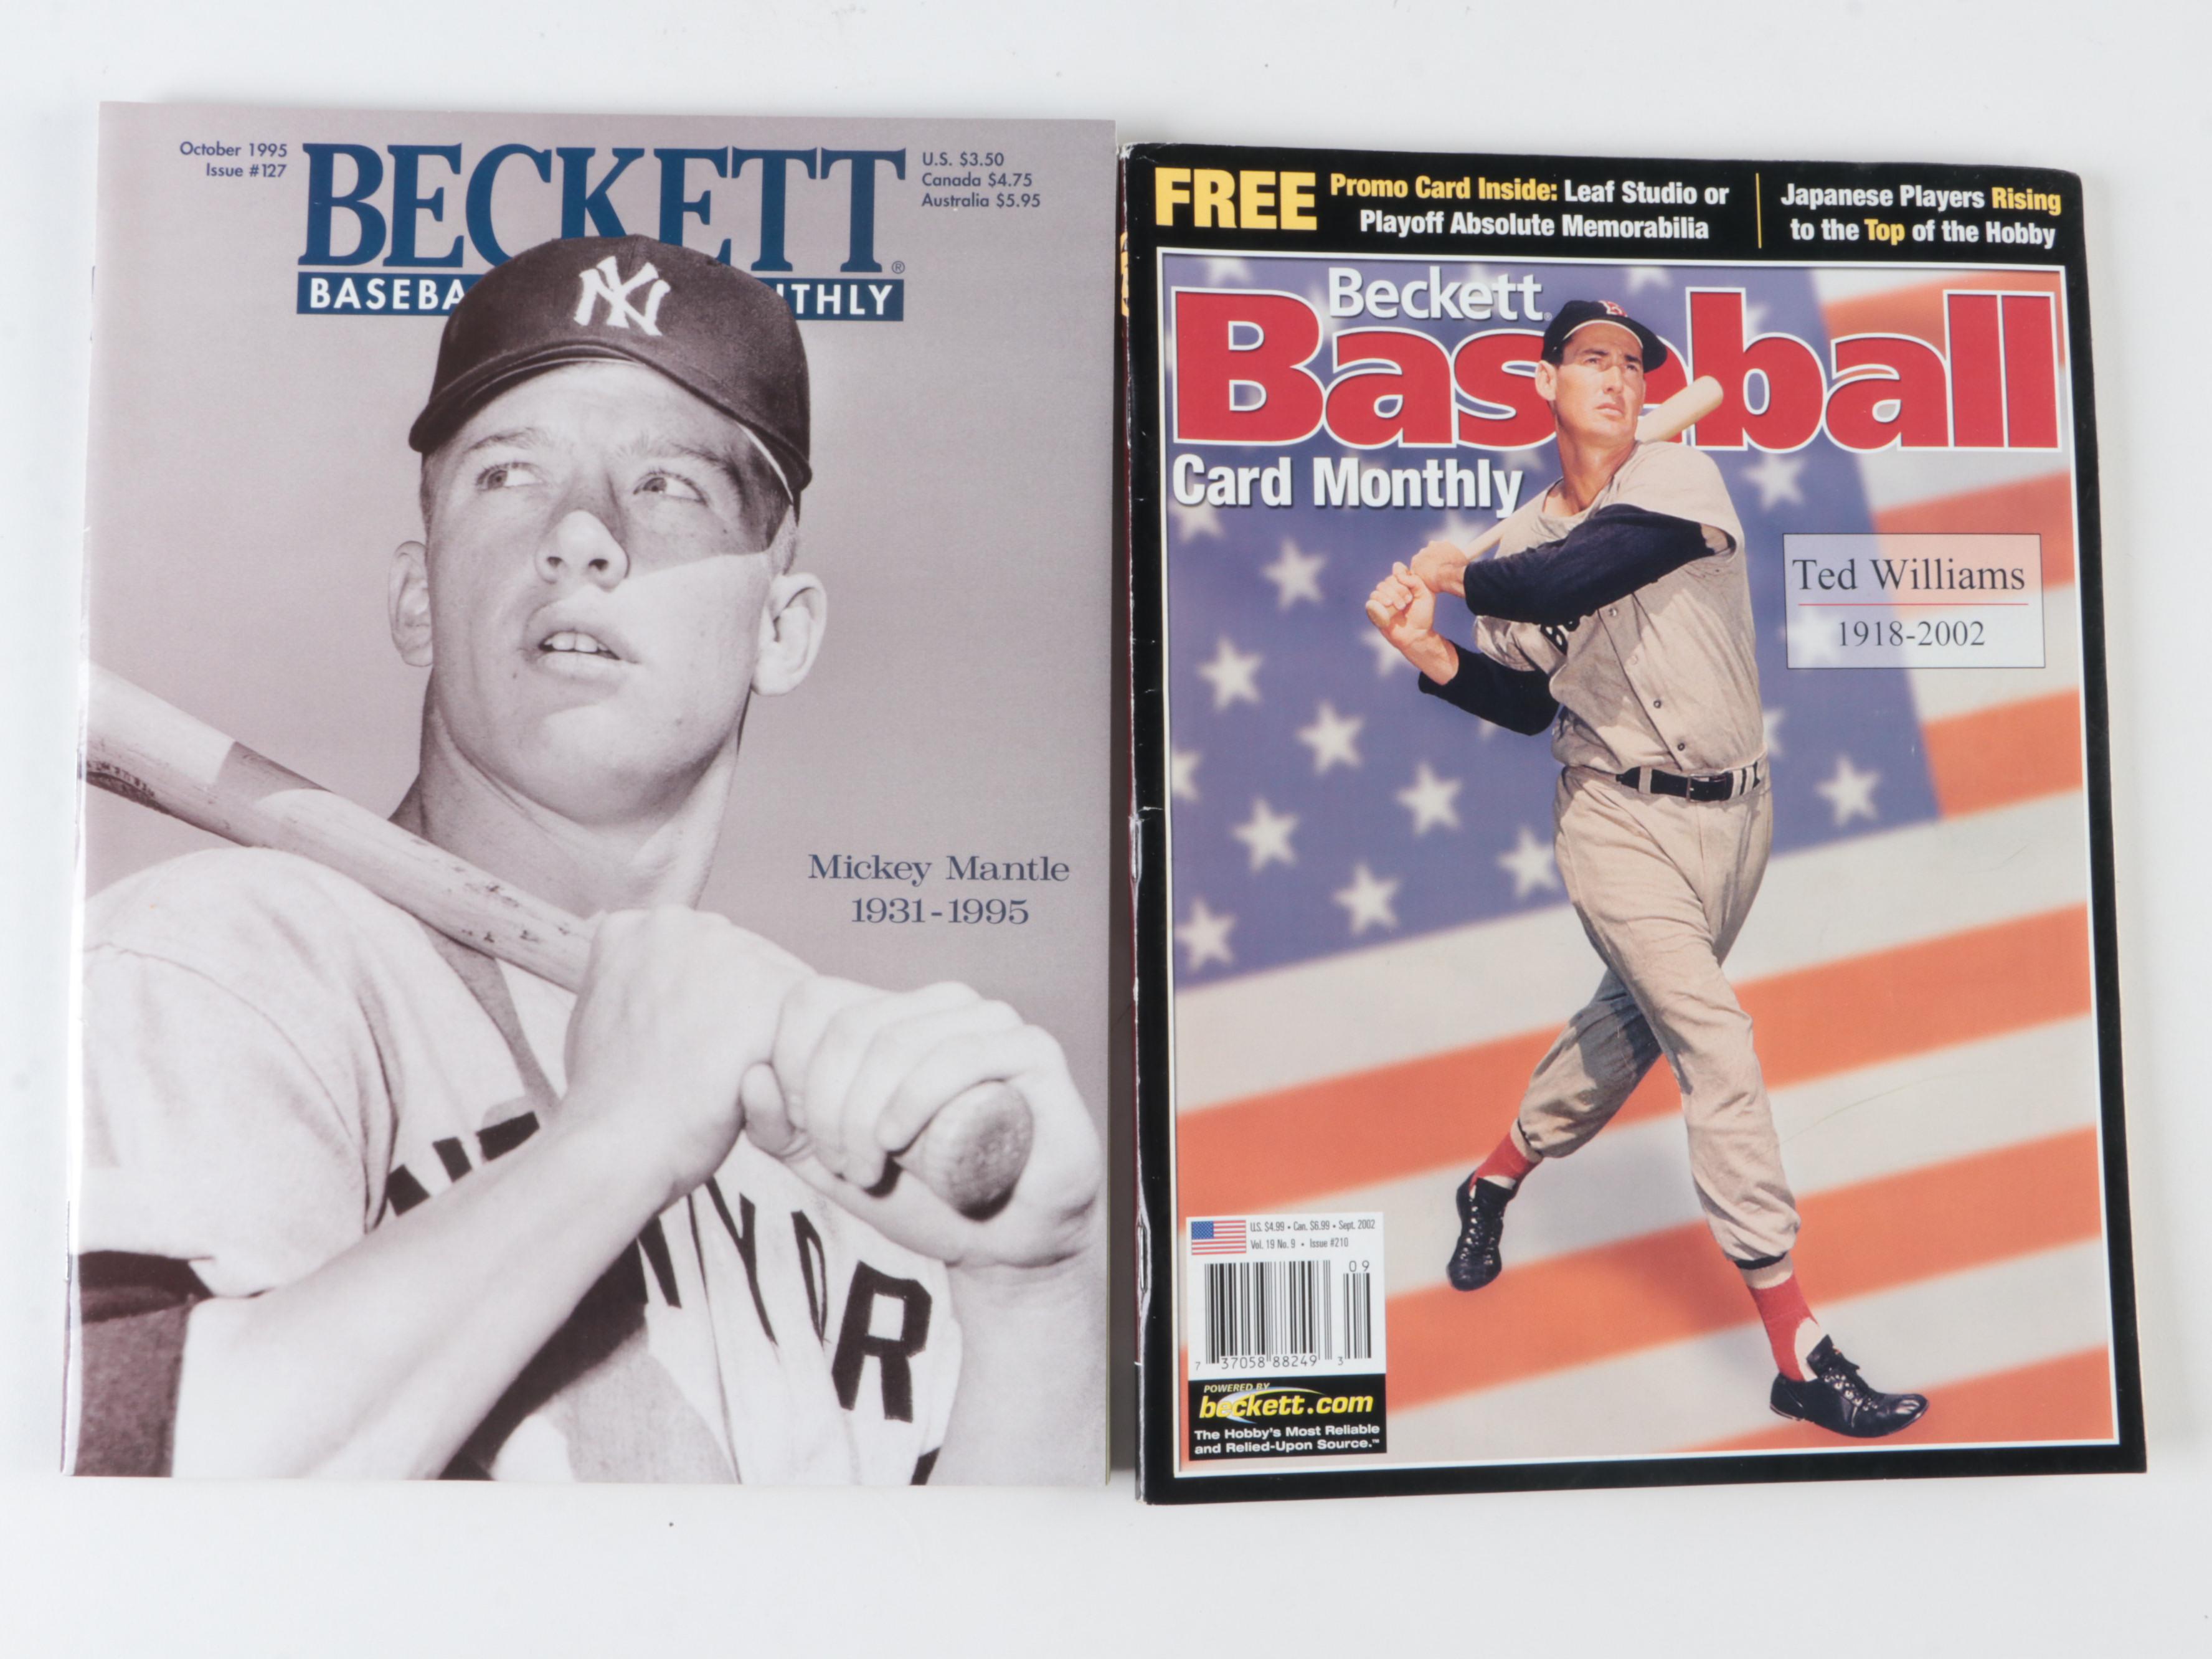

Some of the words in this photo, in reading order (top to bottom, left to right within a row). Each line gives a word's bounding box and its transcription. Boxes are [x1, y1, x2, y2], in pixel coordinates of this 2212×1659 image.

[179, 141, 241, 158] October
[249, 143, 287, 158] 1995
[922, 152, 953, 166] U.S.
[960, 151, 1004, 168] $3.50
[206, 163, 243, 178] Issue
[249, 164, 286, 179] #127
[922, 172, 981, 187] Canada
[988, 173, 1033, 188] $4.75
[921, 192, 990, 209] Australia
[996, 193, 1041, 209] $5.95
[1154, 167, 1318, 230] FREE
[1330, 174, 1408, 199] Promo
[1415, 176, 1471, 200] Card
[1478, 178, 1558, 203] Inside:
[1564, 179, 1615, 203] Leaf
[1622, 181, 1698, 205] Studio
[1704, 189, 1729, 206] or
[1781, 183, 1893, 209] Japanese
[1900, 185, 1985, 211] Players
[1992, 187, 2061, 215] Rising
[297, 143, 906, 273] BECKETT
[1359, 209, 1445, 239] Playoff
[1450, 212, 1555, 237] Absolute
[1562, 214, 1709, 240] Memorabilia
[1790, 219, 1815, 240] to
[1821, 219, 1860, 240] the
[1864, 219, 1906, 246] Top
[1912, 219, 1936, 242] of
[1941, 220, 1980, 242] the
[1987, 221, 2056, 250] Hobby
[310, 277, 465, 310] BASEBA
[1328, 267, 1544, 322] Beckett
[1171, 285, 2063, 452] Basball
[1172, 453, 1293, 508] Card
[1313, 457, 1523, 519] Monthly
[1792, 559, 1858, 590] Ted
[1870, 559, 2026, 590] Williams
[1839, 621, 1985, 646] 1918-2002
[808, 854, 932, 887] Mickey
[946, 856, 1070, 881] Mantle
[851, 897, 1029, 925] 1931-1995
[1250, 1222, 1262, 1232] U.S.
[1265, 1221, 1285, 1232] $4.99
[1293, 1221, 1308, 1231] Can.
[1310, 1219, 1330, 1231] $6.99
[1339, 1219, 1355, 1231] Sept.
[1358, 1219, 1375, 1229] 2002
[1250, 1239, 1263, 1250] Vol.
[1266, 1238, 1275, 1249] 19
[1277, 1239, 1289, 1249] No.
[1291, 1238, 1295, 1248] 9
[1310, 1237, 1328, 1248] Issue
[1330, 1237, 1348, 1247] #210
[1194, 1361, 1201, 1371] 7
[1221, 1356, 1266, 1370] 37058
[1272, 1354, 1318, 1368] 88249
[1337, 1356, 1344, 1366] 3
[1203, 1383, 1254, 1394] POWERED
[1255, 1382, 1270, 1391] BY
[1199, 1395, 1374, 1419] beckett.com
[1194, 1430, 1220, 1440] The
[1224, 1427, 1282, 1440] Hobby's
[1285, 1425, 1321, 1438] Most
[1325, 1424, 1380, 1437] Reliable
[1194, 1442, 1222, 1454] and
[1226, 1440, 1313, 1454] Relied-Upon
